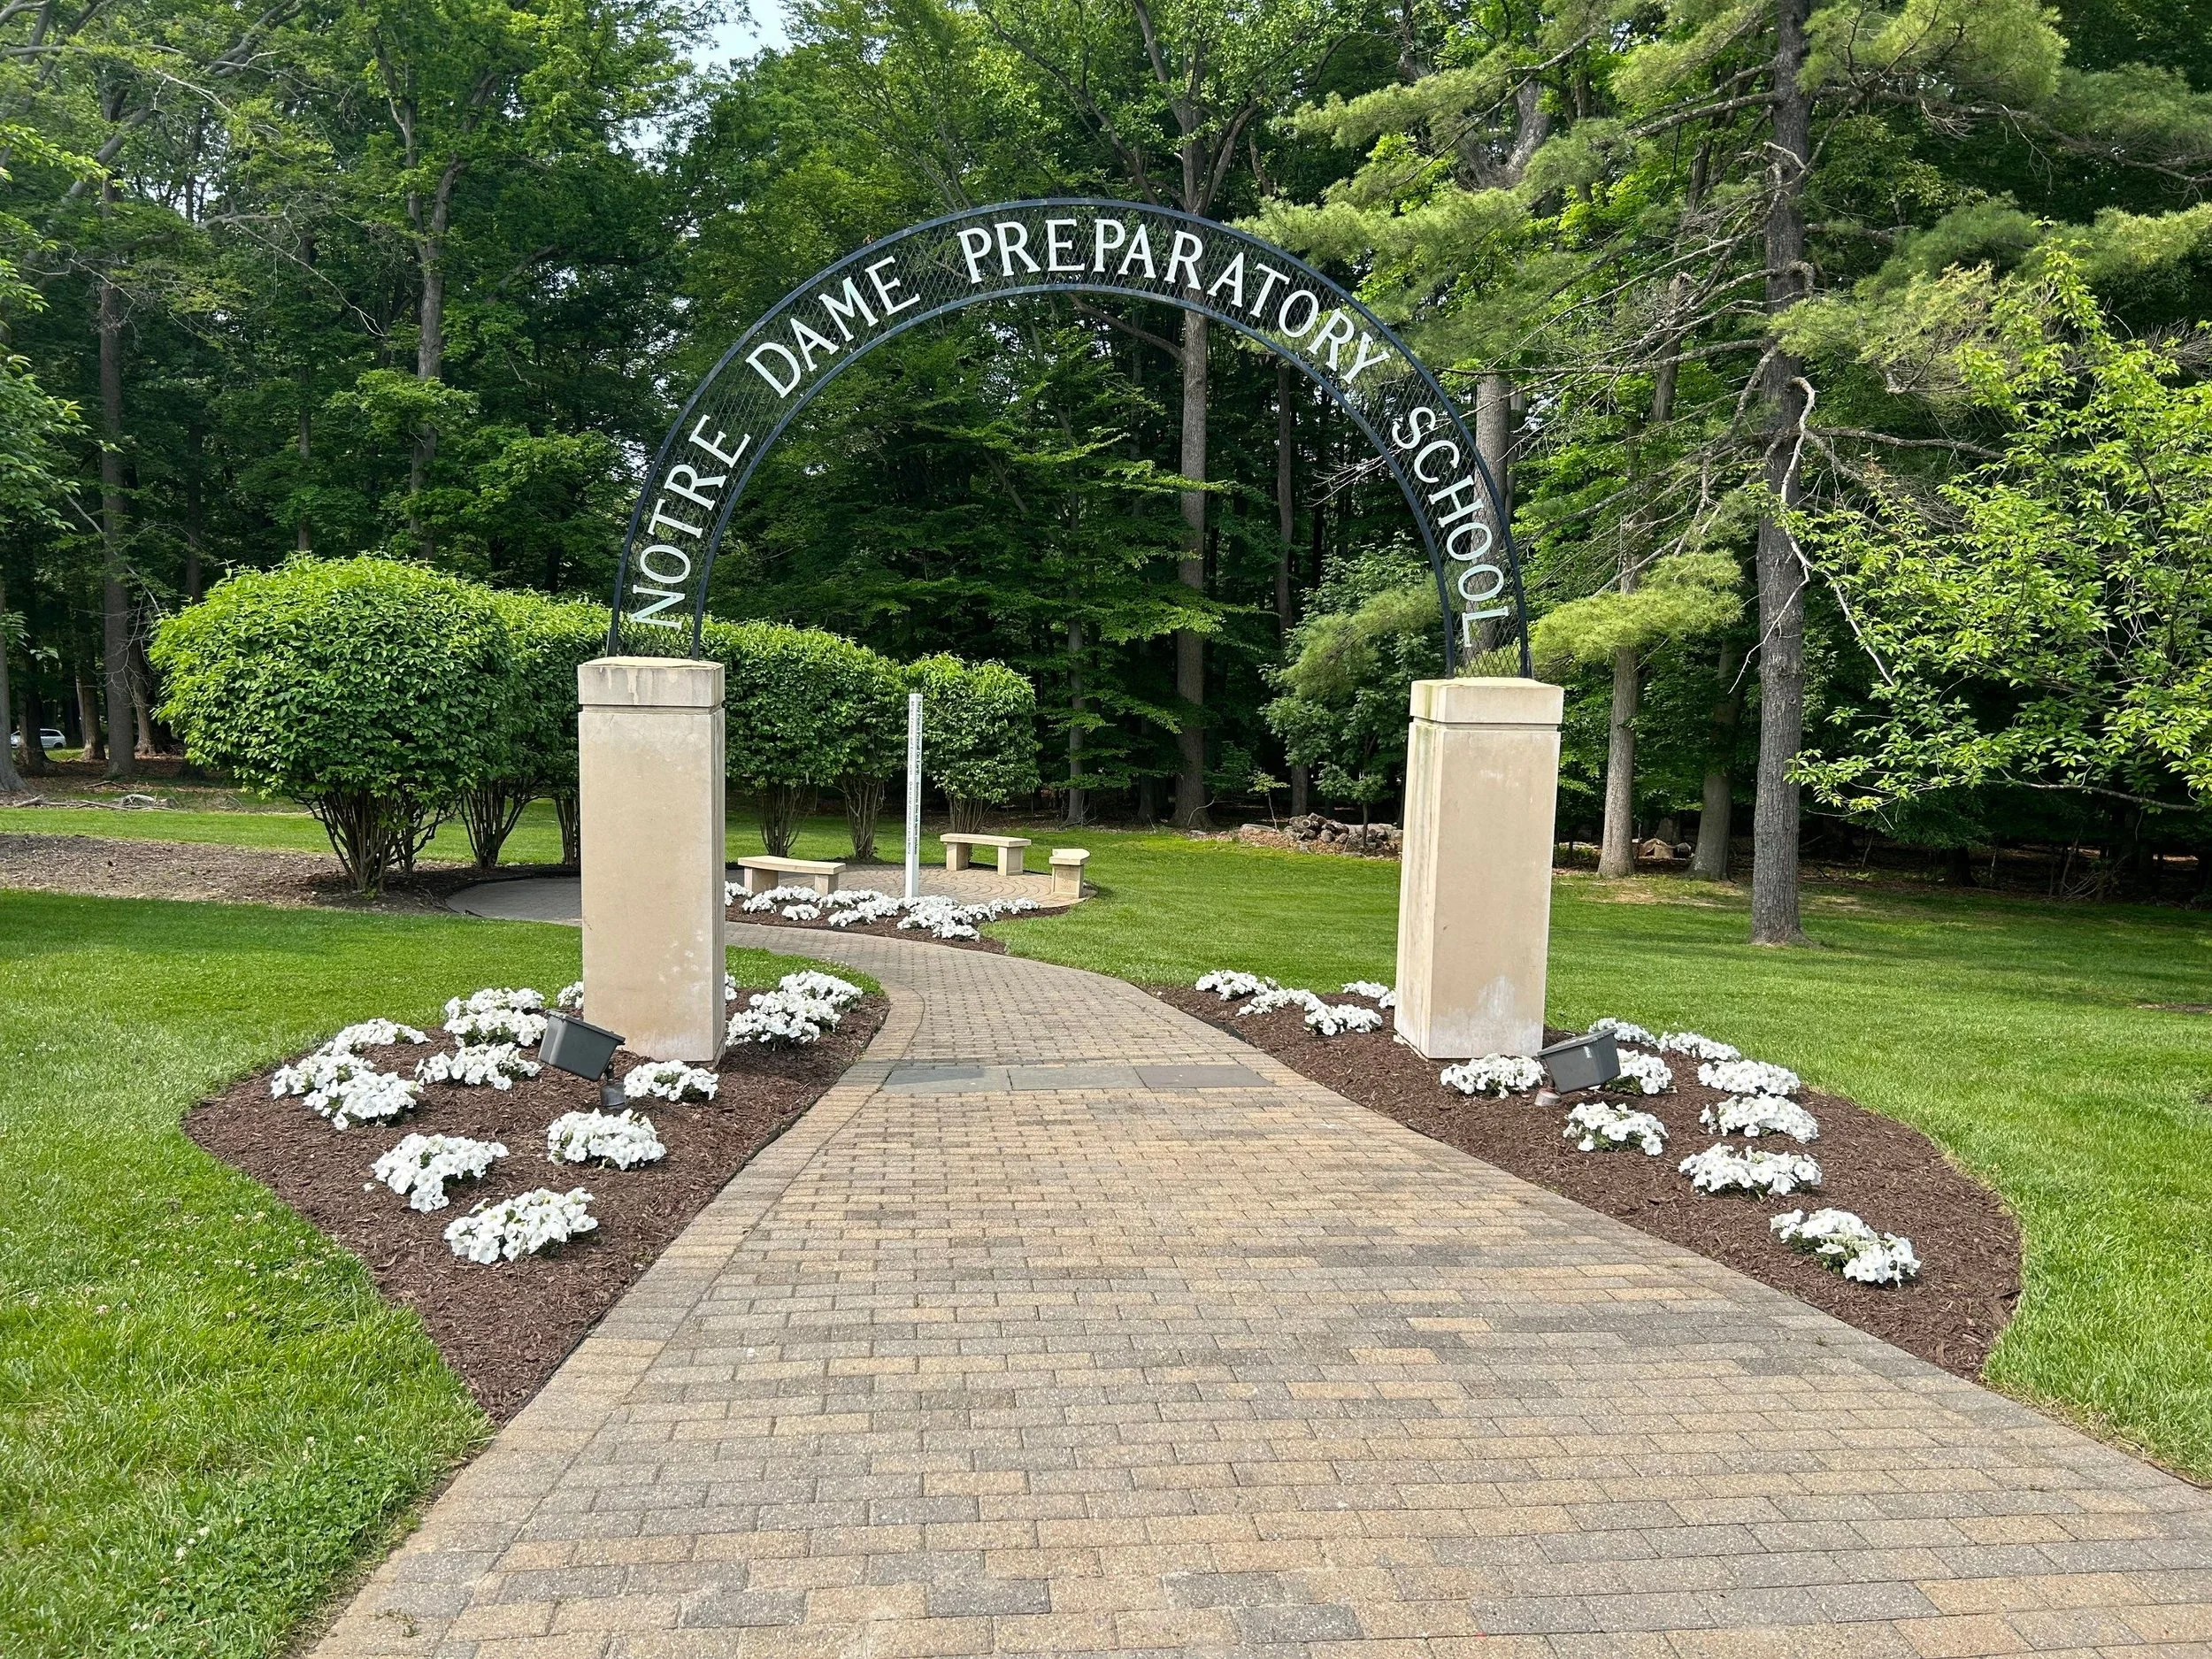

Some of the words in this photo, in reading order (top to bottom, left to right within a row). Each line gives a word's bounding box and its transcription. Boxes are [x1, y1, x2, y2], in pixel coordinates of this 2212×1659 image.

[629, 414, 750, 629] NOTRE
[745, 256, 920, 398] DAME
[957, 219, 1390, 384] PREPARATORY
[1392, 407, 1509, 647] SCHOOL
